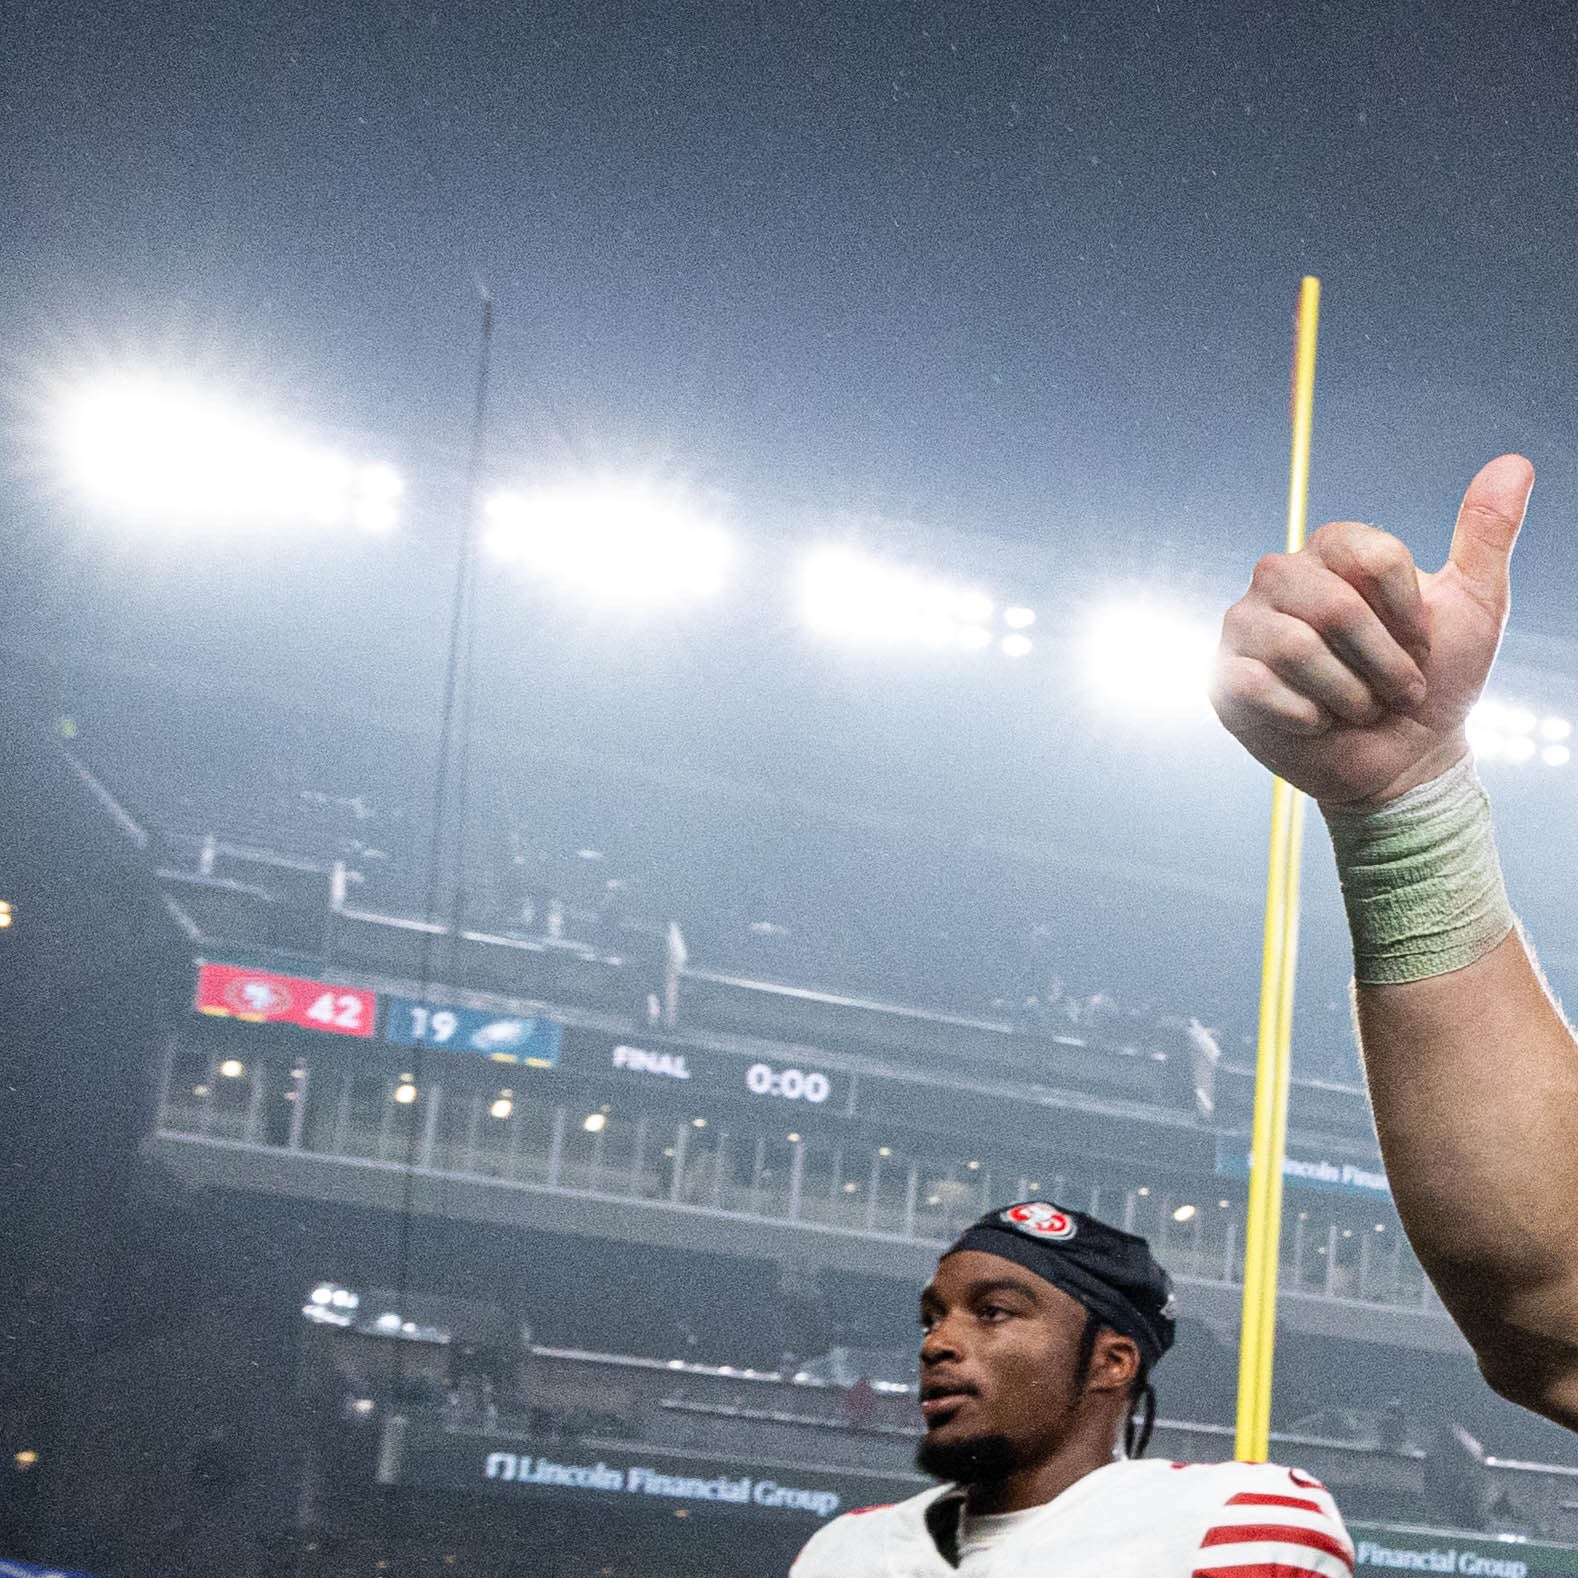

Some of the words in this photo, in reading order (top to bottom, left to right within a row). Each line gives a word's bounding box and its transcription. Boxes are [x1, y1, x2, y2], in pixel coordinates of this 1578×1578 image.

[306, 993, 363, 1030] 42
[411, 1007, 457, 1042] 19
[612, 1045, 690, 1080] FINAL
[746, 1063, 829, 1103] 0:00
[519, 1455, 624, 1492] Lincoln
[626, 1466, 751, 1504] Financial
[754, 1480, 840, 1517] Group
[1356, 1541, 1456, 1573] Financial
